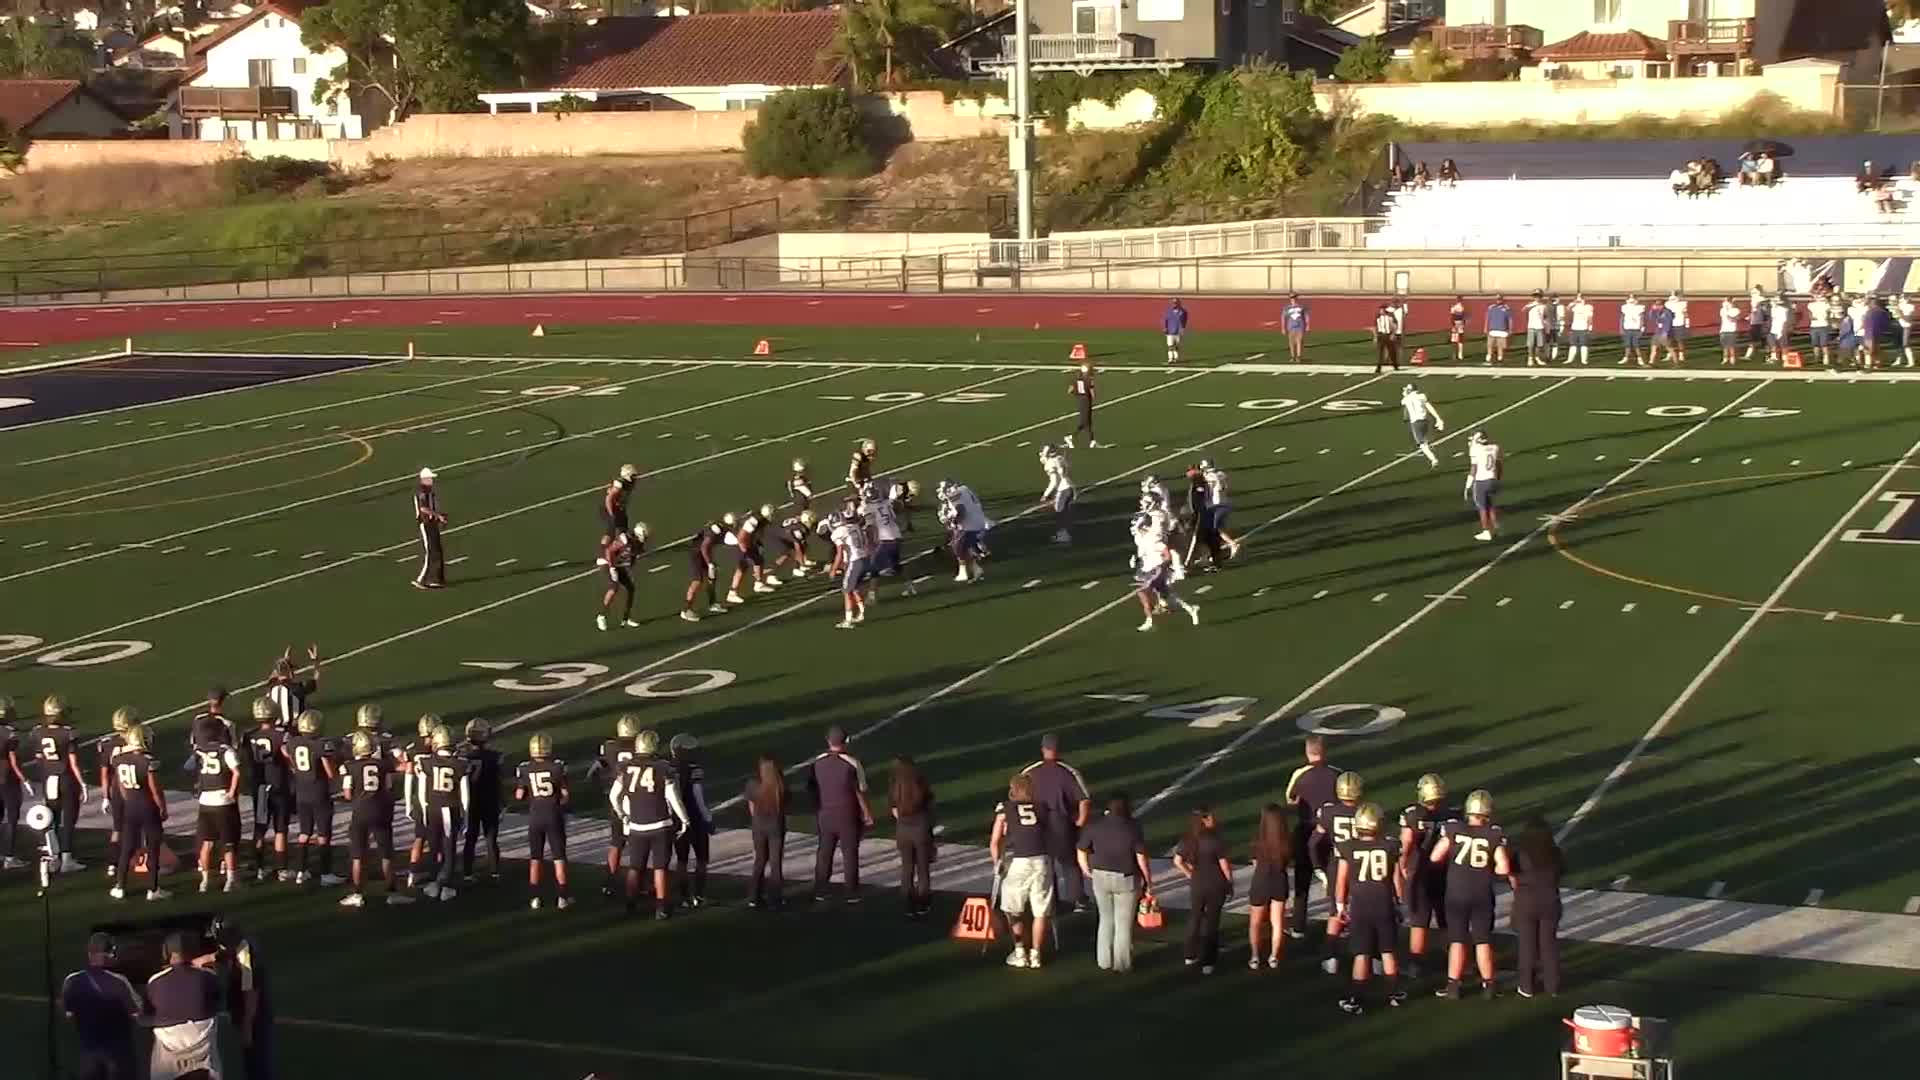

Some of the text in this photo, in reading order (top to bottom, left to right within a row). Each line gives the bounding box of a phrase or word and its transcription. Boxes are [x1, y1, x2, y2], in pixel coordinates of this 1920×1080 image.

[493, 662, 737, 698] 30
[1143, 696, 1407, 736] 40
[41, 737, 60, 761] 2
[295, 745, 310, 772] 8
[363, 764, 379, 792] 6
[432, 766, 455, 793] 16
[528, 770, 554, 798] 15
[627, 766, 655, 793] 74
[1018, 803, 1037, 826] 5
[1353, 849, 1388, 882] 78
[1454, 834, 1489, 869] 76
[962, 904, 987, 932] 40
